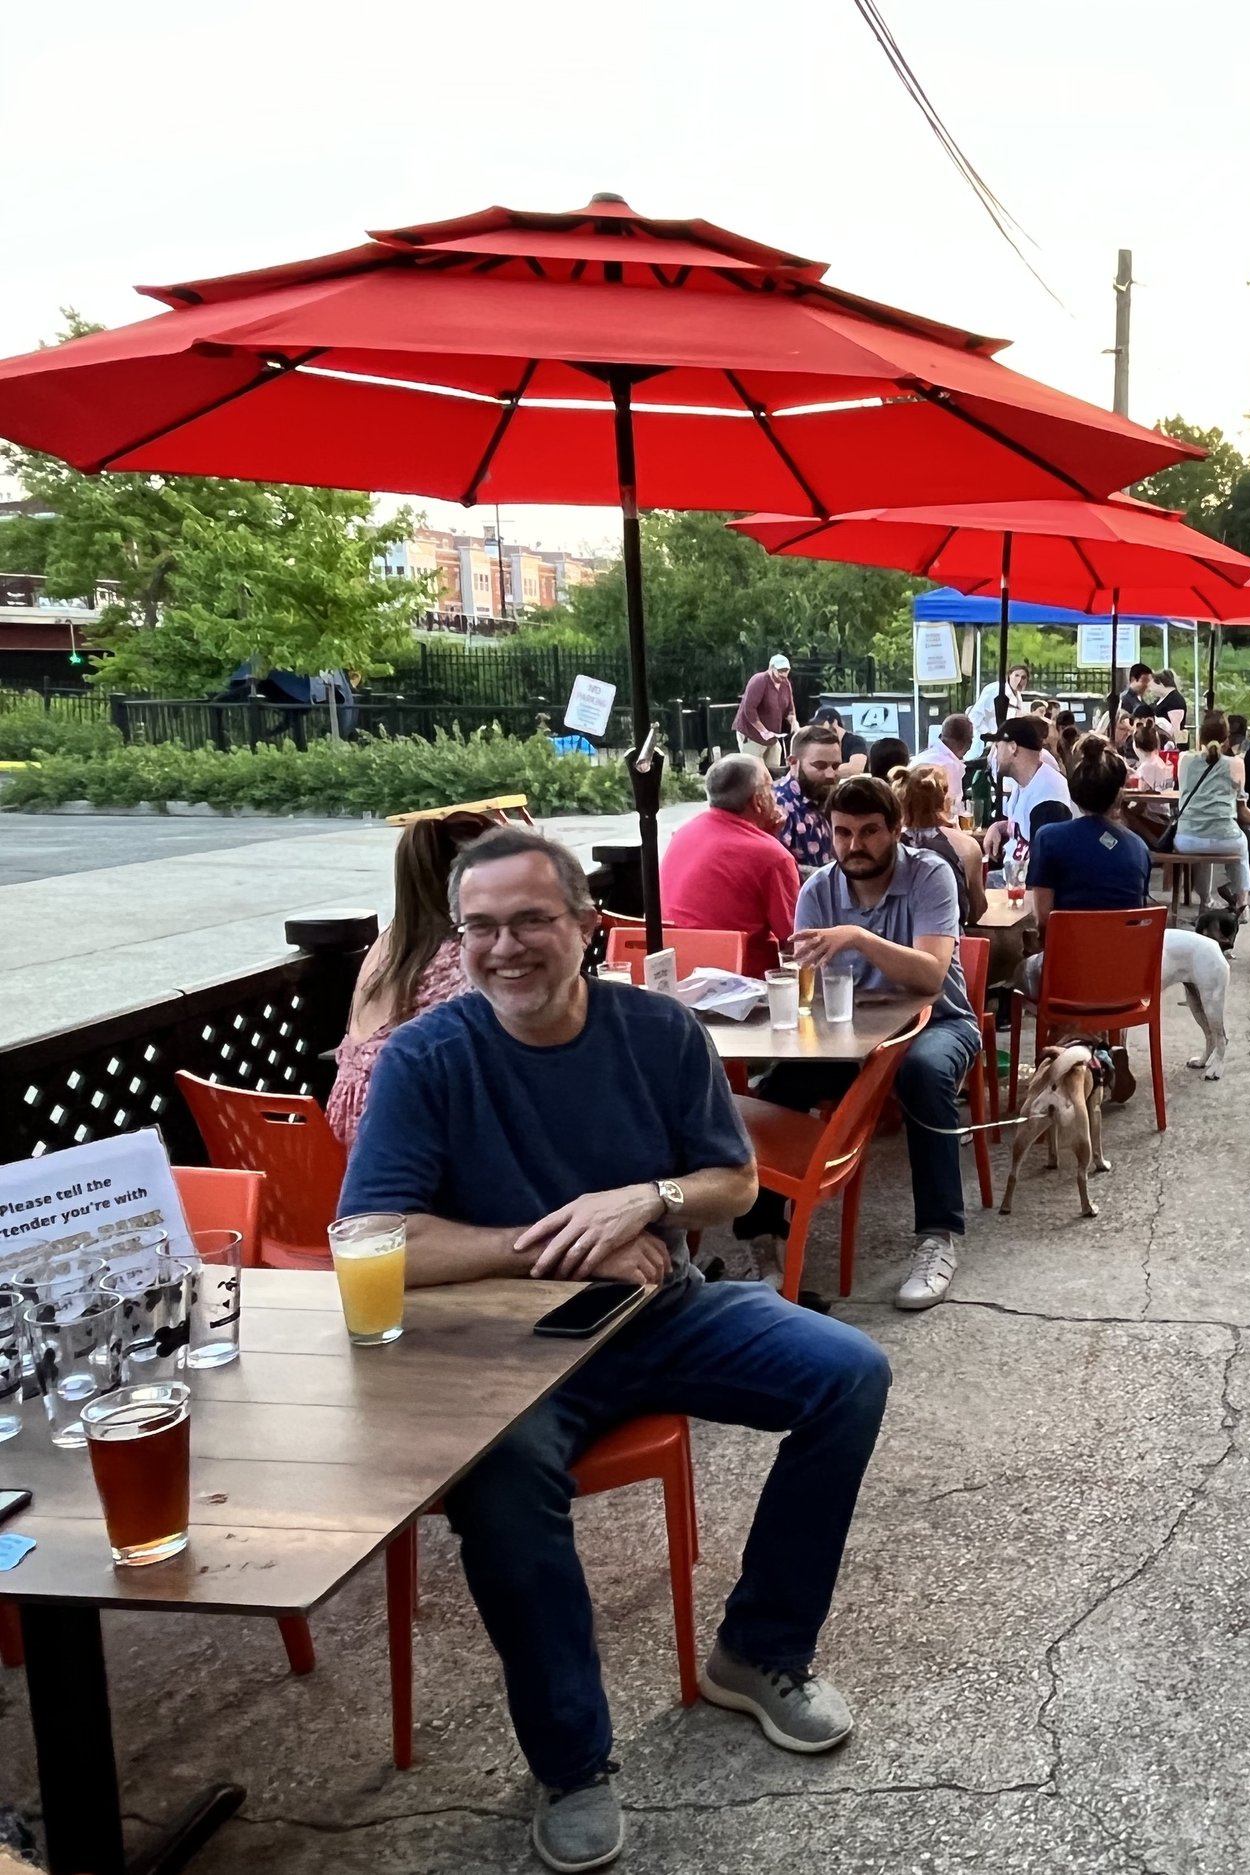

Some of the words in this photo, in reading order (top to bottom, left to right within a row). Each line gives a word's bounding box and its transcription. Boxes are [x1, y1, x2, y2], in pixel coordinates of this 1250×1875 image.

[0, 1195, 52, 1217] Please
[56, 1183, 82, 1200] tell
[86, 1178, 112, 1193] the
[61, 1199, 111, 1225] you're
[114, 1187, 148, 1205] with
